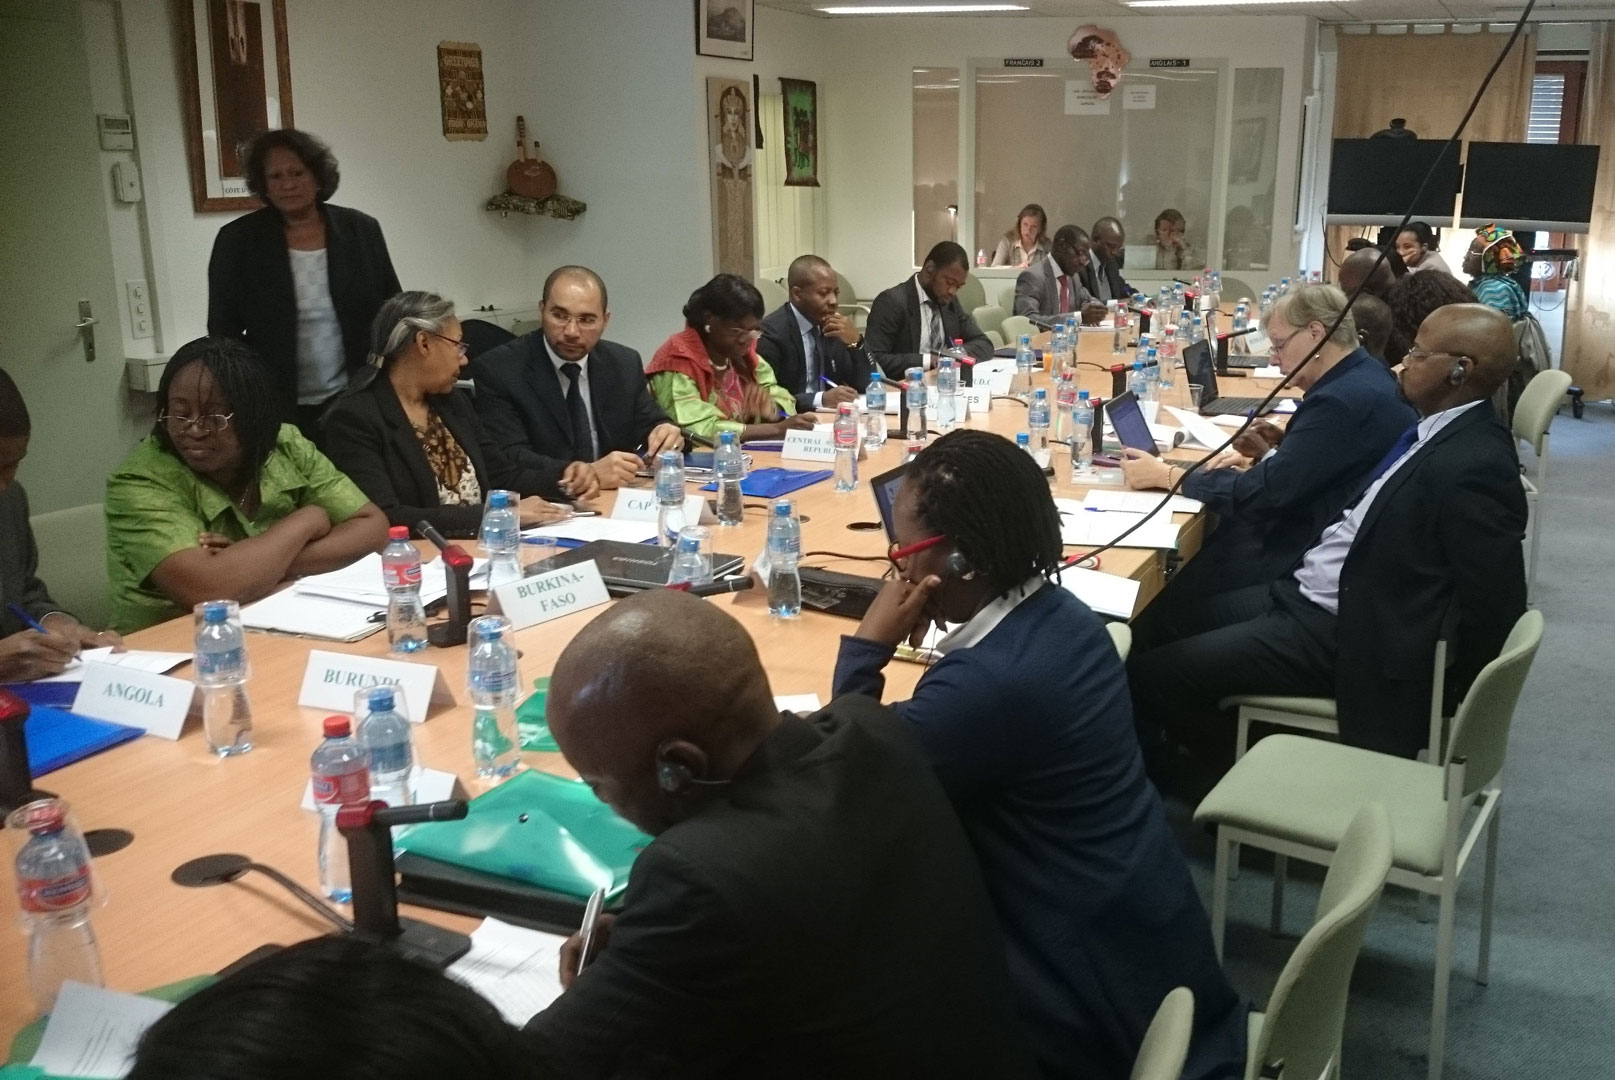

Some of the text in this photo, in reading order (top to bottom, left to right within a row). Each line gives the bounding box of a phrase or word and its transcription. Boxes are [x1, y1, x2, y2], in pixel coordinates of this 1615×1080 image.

[444, 55, 480, 68] GREETINGS
[787, 436, 822, 446] CENTRAL
[803, 446, 838, 455] REPUBLI
[627, 499, 652, 511] CAP
[540, 592, 577, 612] FASO
[102, 682, 165, 708] ANGOLA
